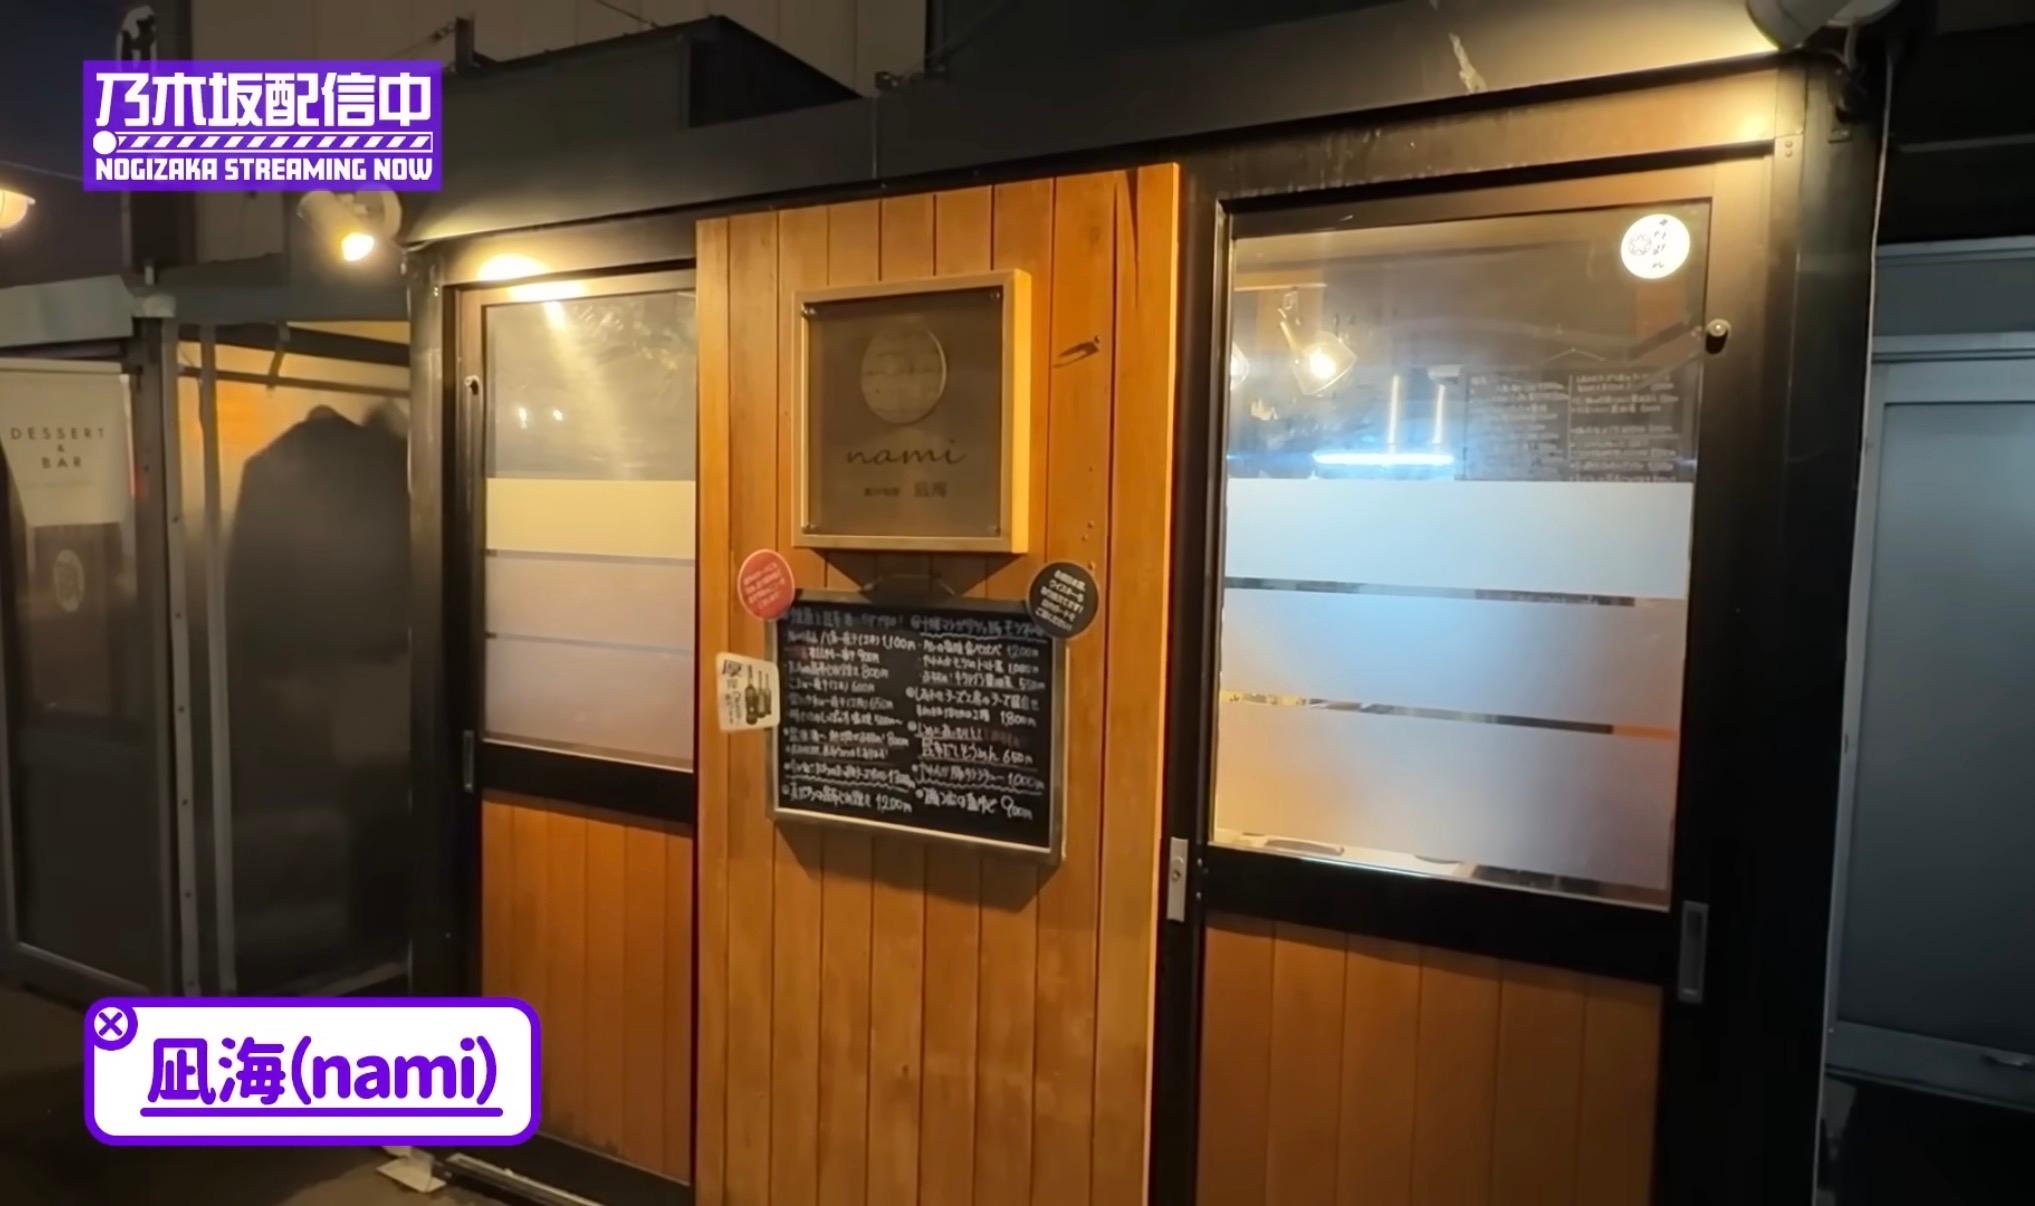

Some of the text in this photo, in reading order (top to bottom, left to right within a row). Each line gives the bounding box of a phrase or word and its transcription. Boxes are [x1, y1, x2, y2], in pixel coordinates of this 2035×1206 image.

[10, 427, 104, 440] DESSERT
[846, 438, 968, 465] nami
[41, 457, 82, 469] BAR
